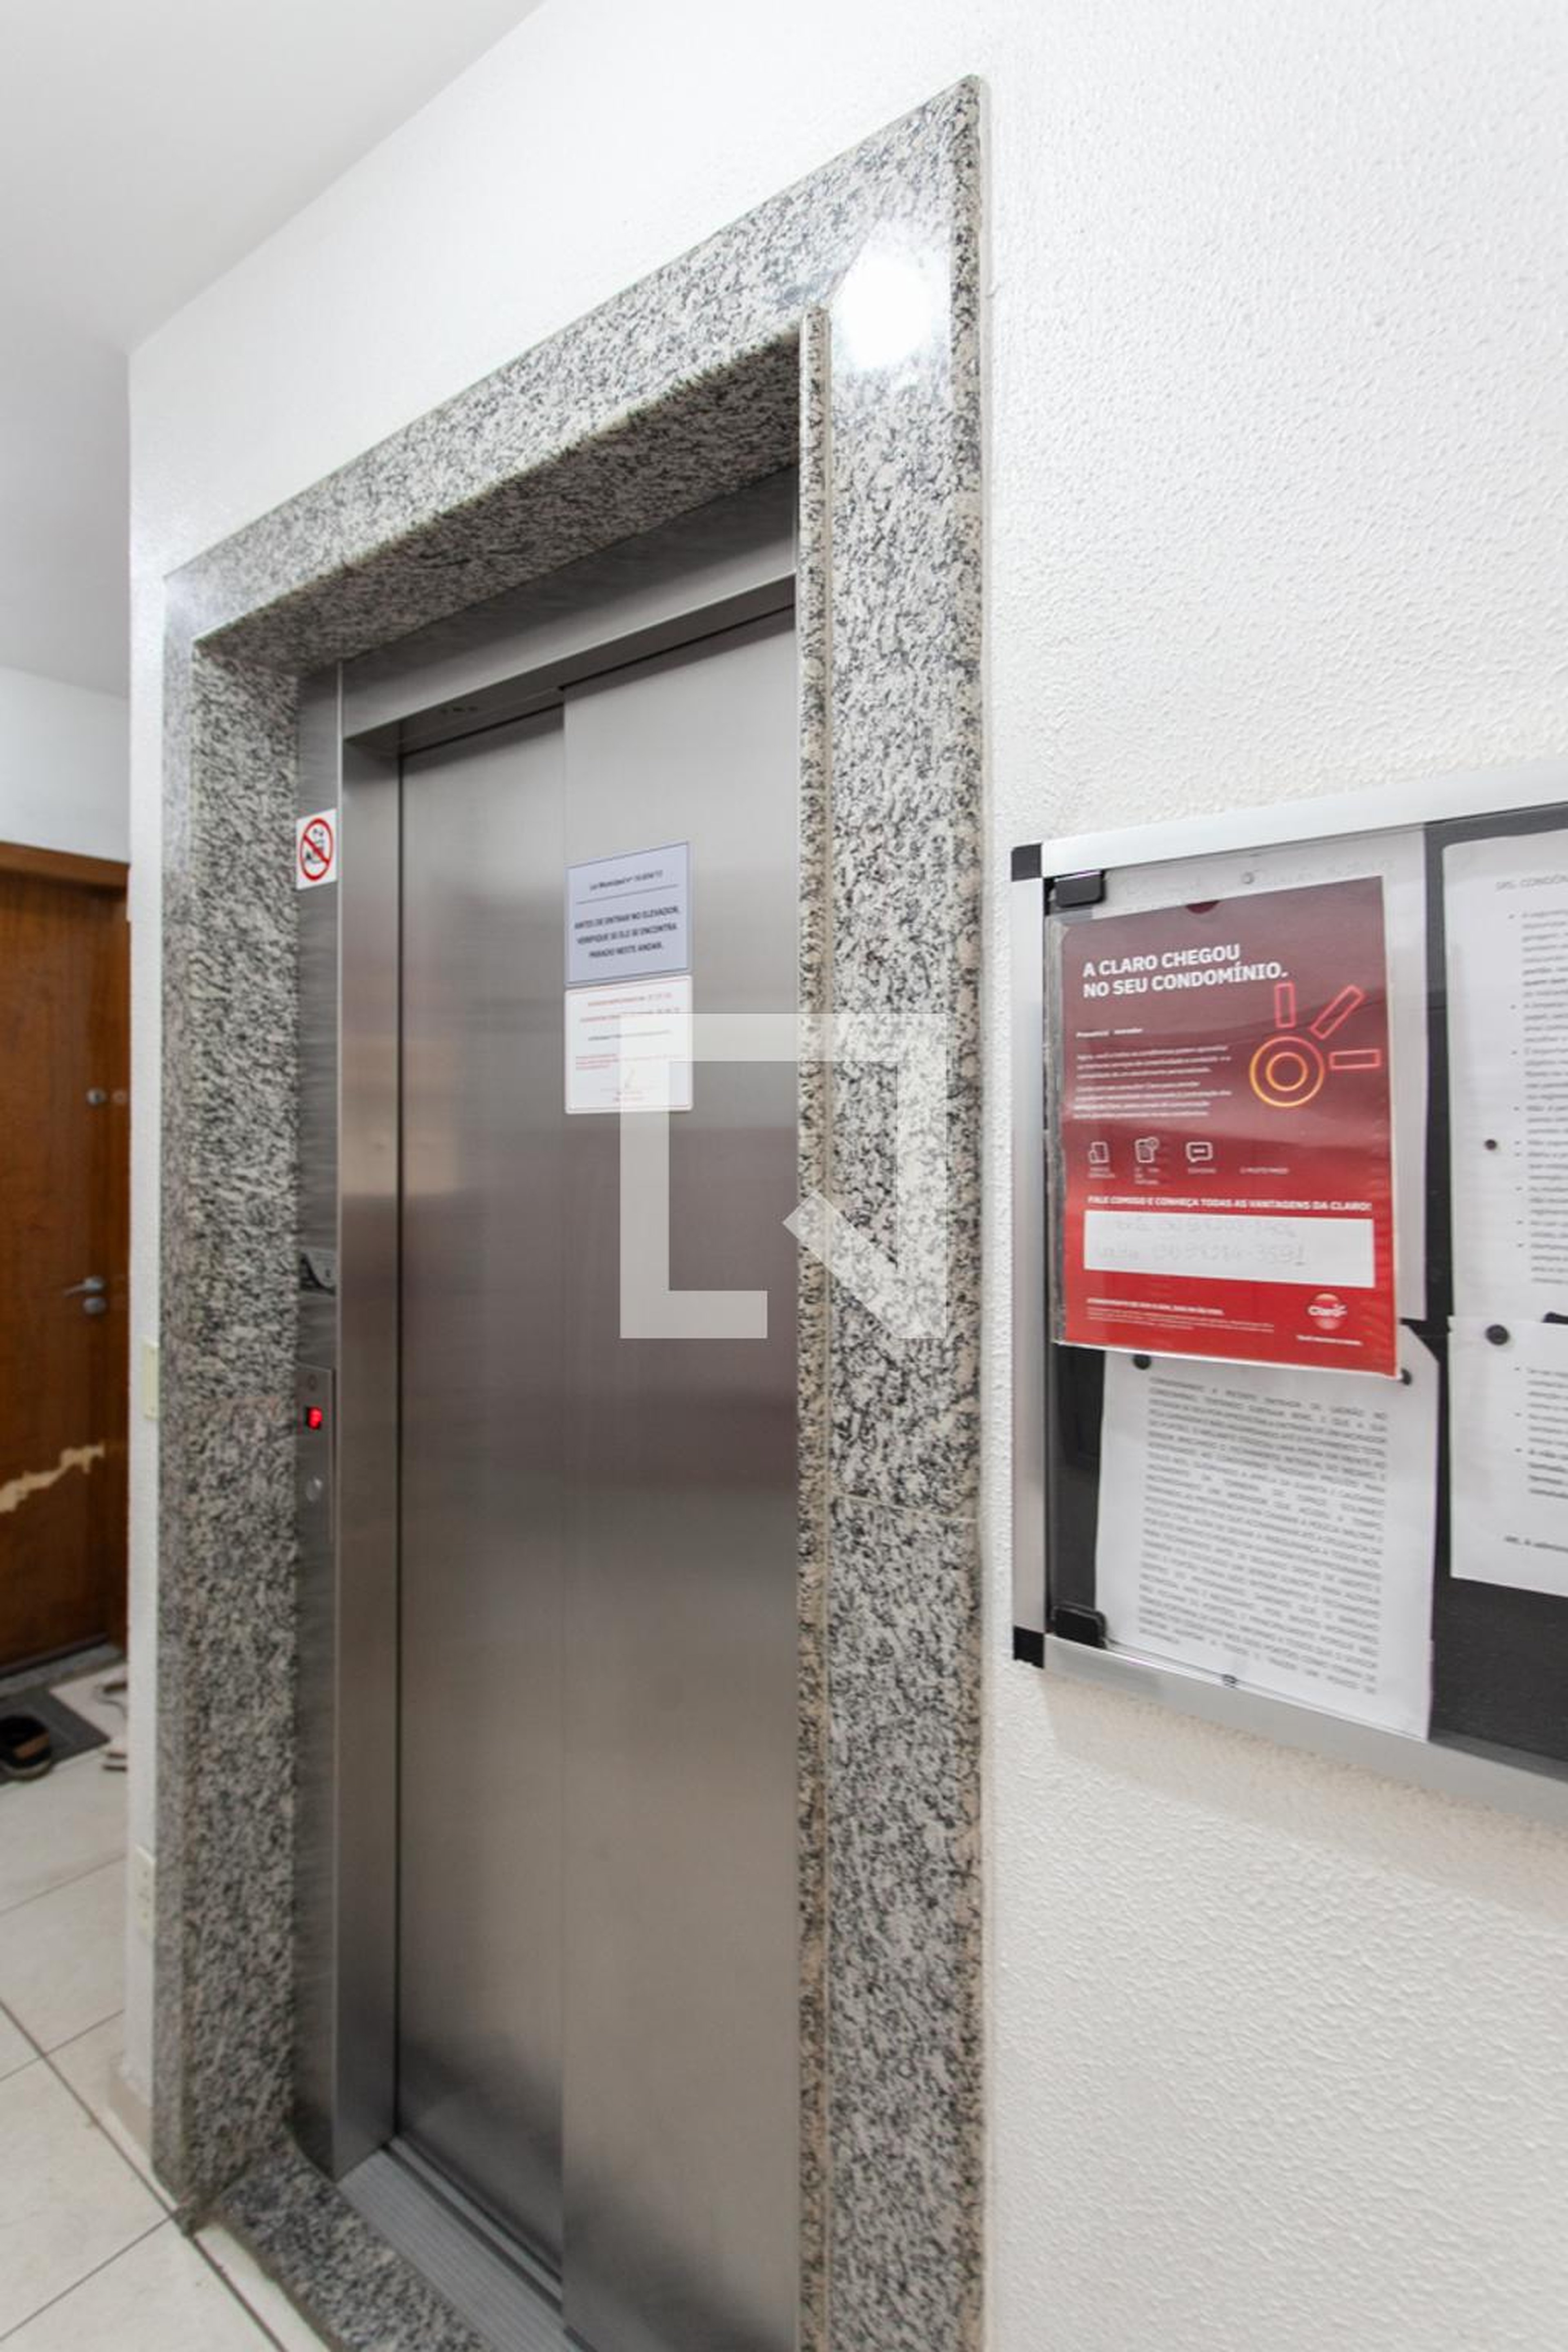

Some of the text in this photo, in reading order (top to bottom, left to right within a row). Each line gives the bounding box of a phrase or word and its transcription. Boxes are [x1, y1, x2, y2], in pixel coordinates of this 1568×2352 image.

[1082, 943, 1240, 978] A CLARO CHEGOU
[1083, 961, 1288, 998] NO SEU CONDOMÍNIO.
